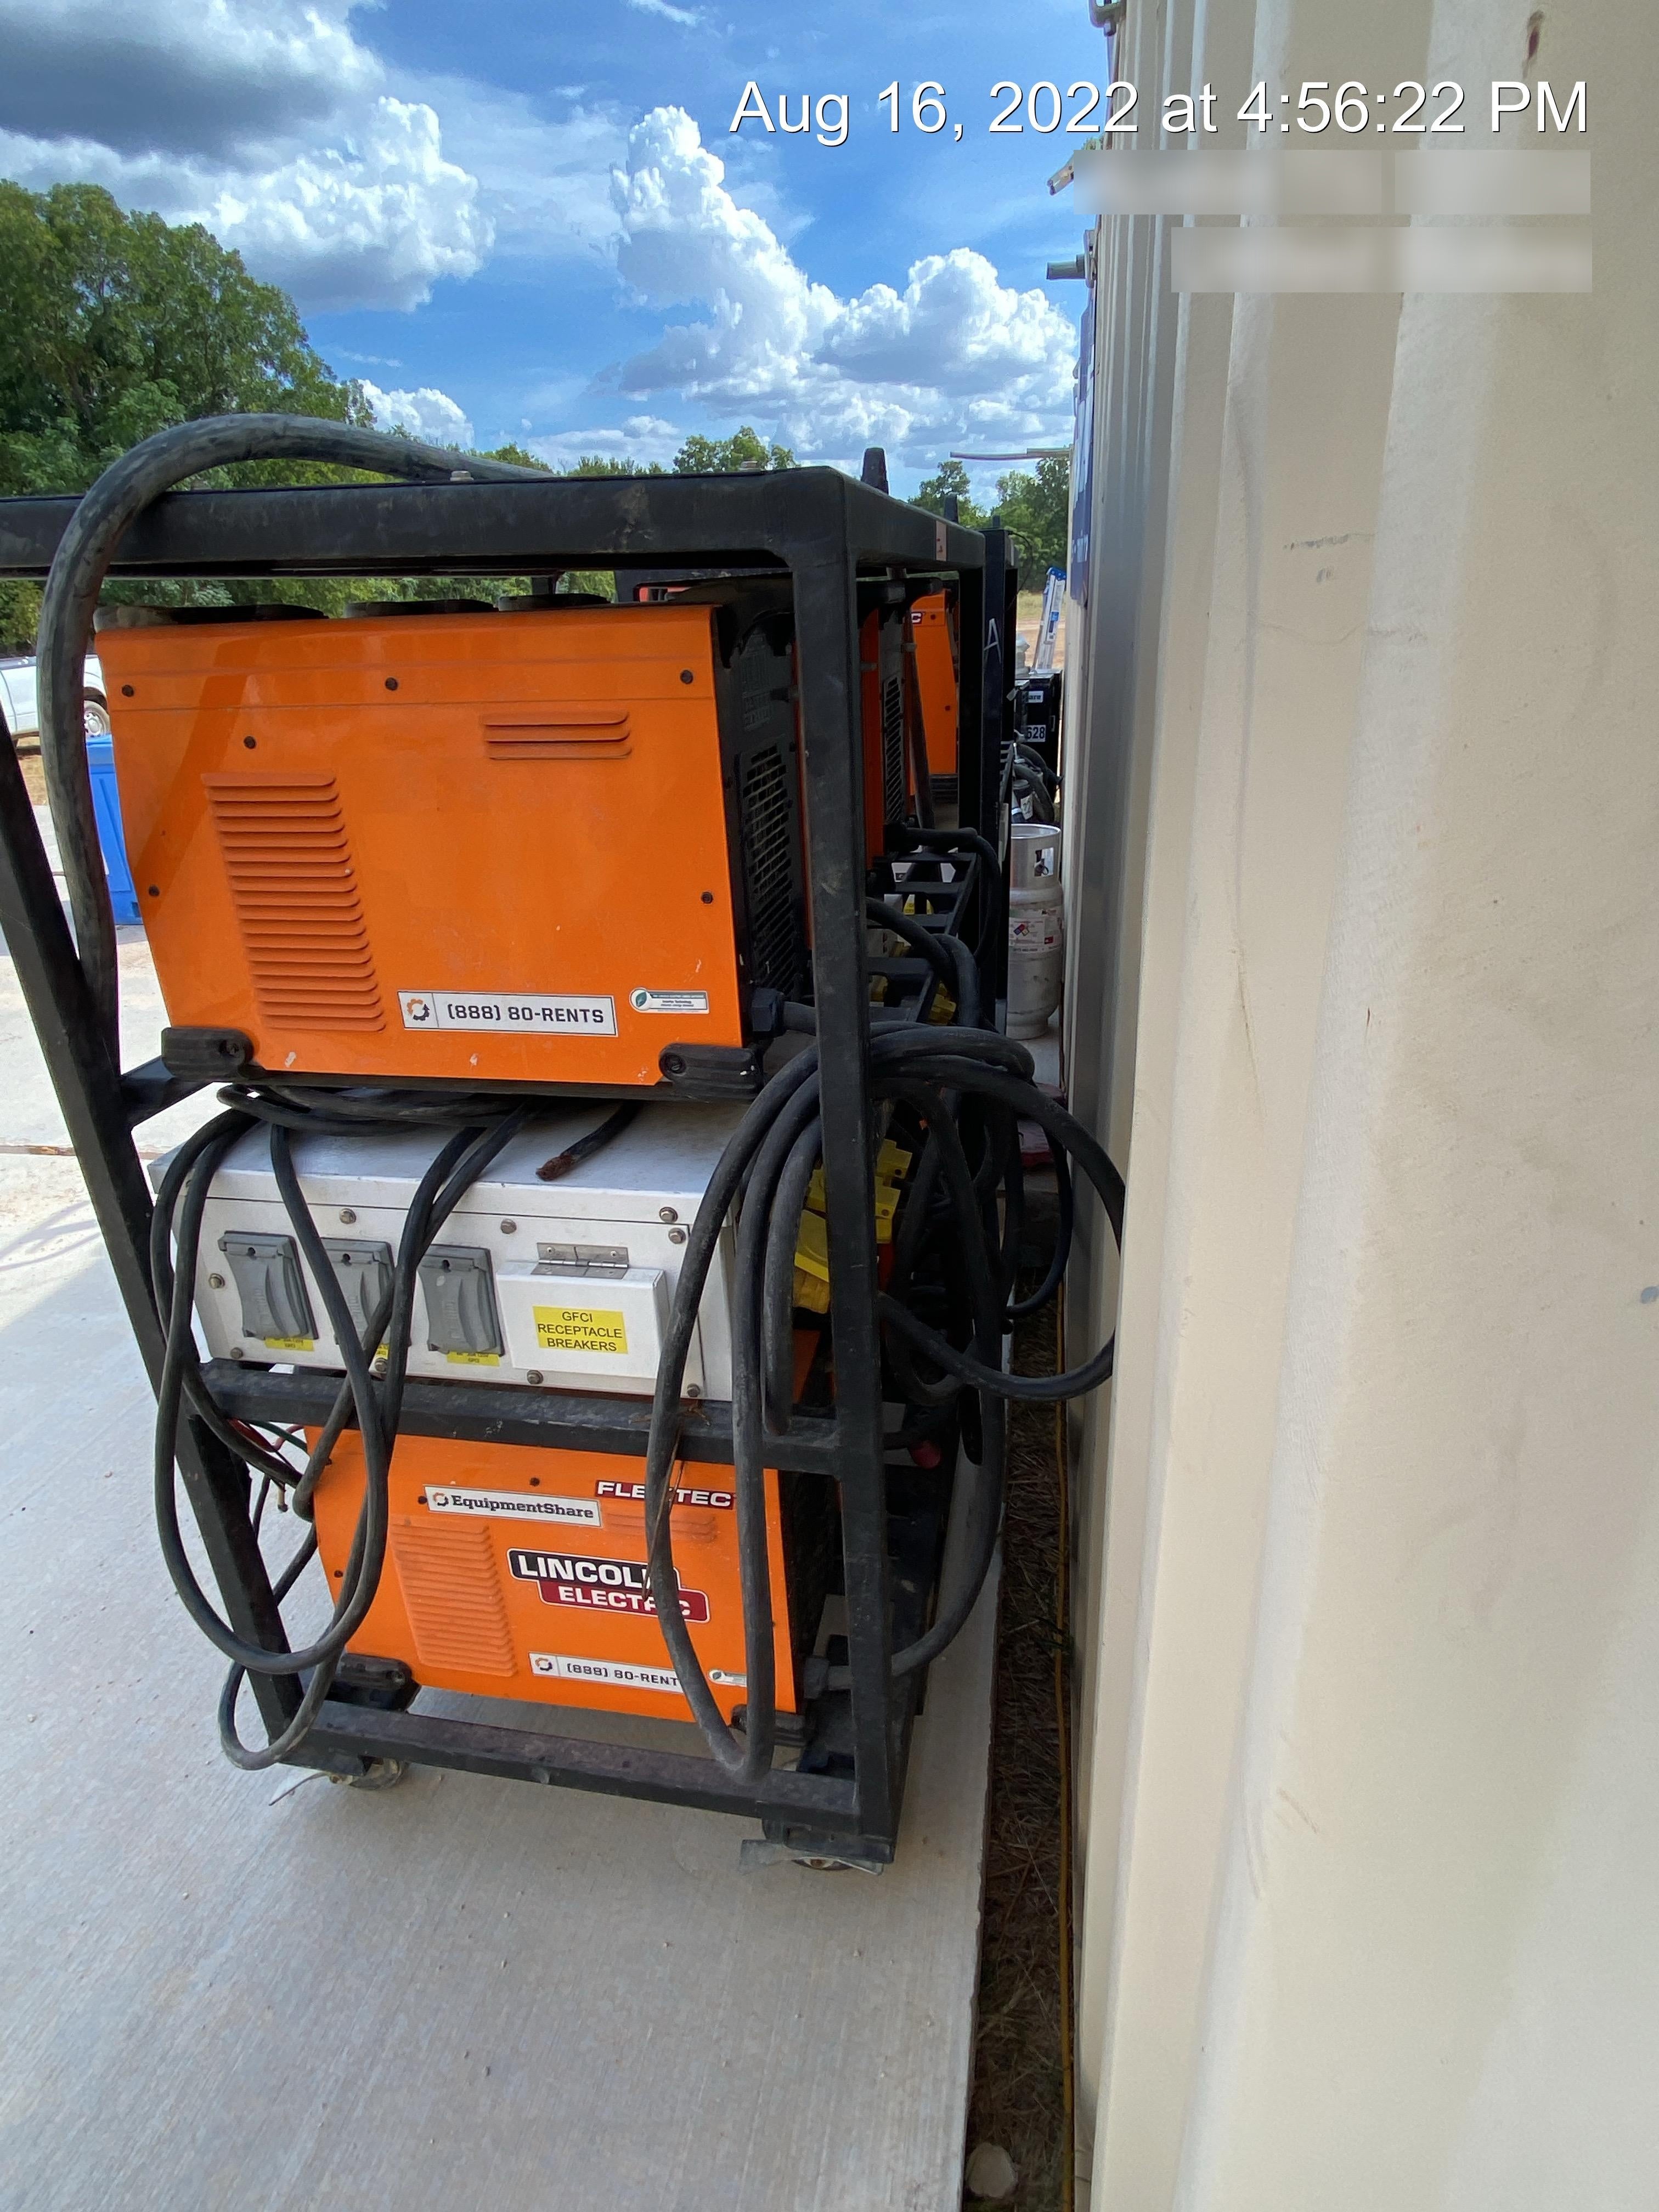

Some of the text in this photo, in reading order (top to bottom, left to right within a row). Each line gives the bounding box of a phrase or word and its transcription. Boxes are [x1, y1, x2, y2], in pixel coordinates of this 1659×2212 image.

[447, 1003, 605, 1024] (888) 80-RENTS
[562, 1311, 593, 1323] GFCI
[537, 1323, 623, 1339] RECEPTACLE
[546, 1338, 617, 1352] BREAKERS
[597, 1481, 732, 1508] FLETEC
[450, 1494, 594, 1519] EquipmentShare
[557, 1585, 691, 1616] ELECTRC
[567, 1662, 679, 1686] (888) 80-RENT
